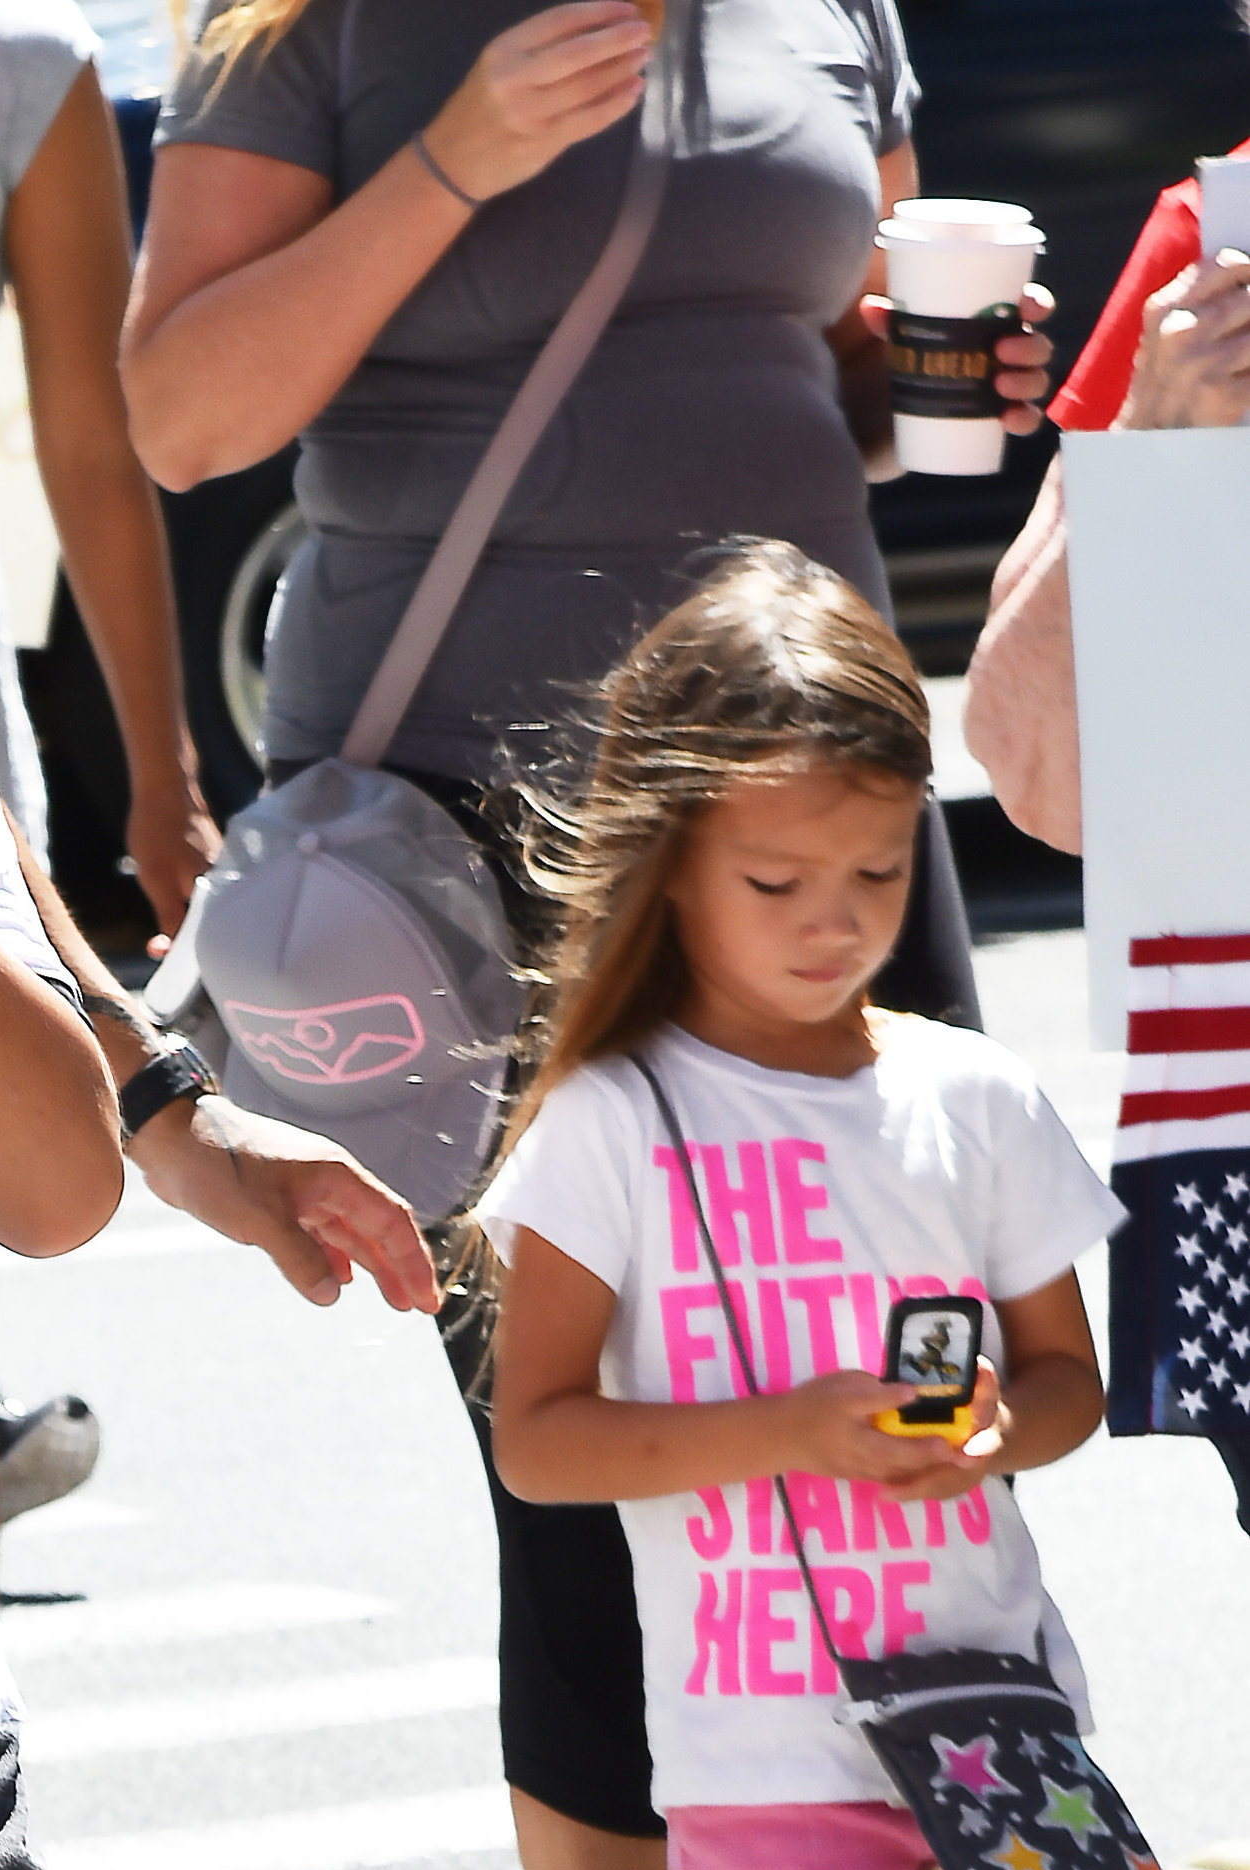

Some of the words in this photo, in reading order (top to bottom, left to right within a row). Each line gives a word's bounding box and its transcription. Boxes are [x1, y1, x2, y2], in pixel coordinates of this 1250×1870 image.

[653, 1137, 843, 1273] THE
[659, 1273, 991, 1403] FUTU
[684, 1560, 932, 1696] HERE
